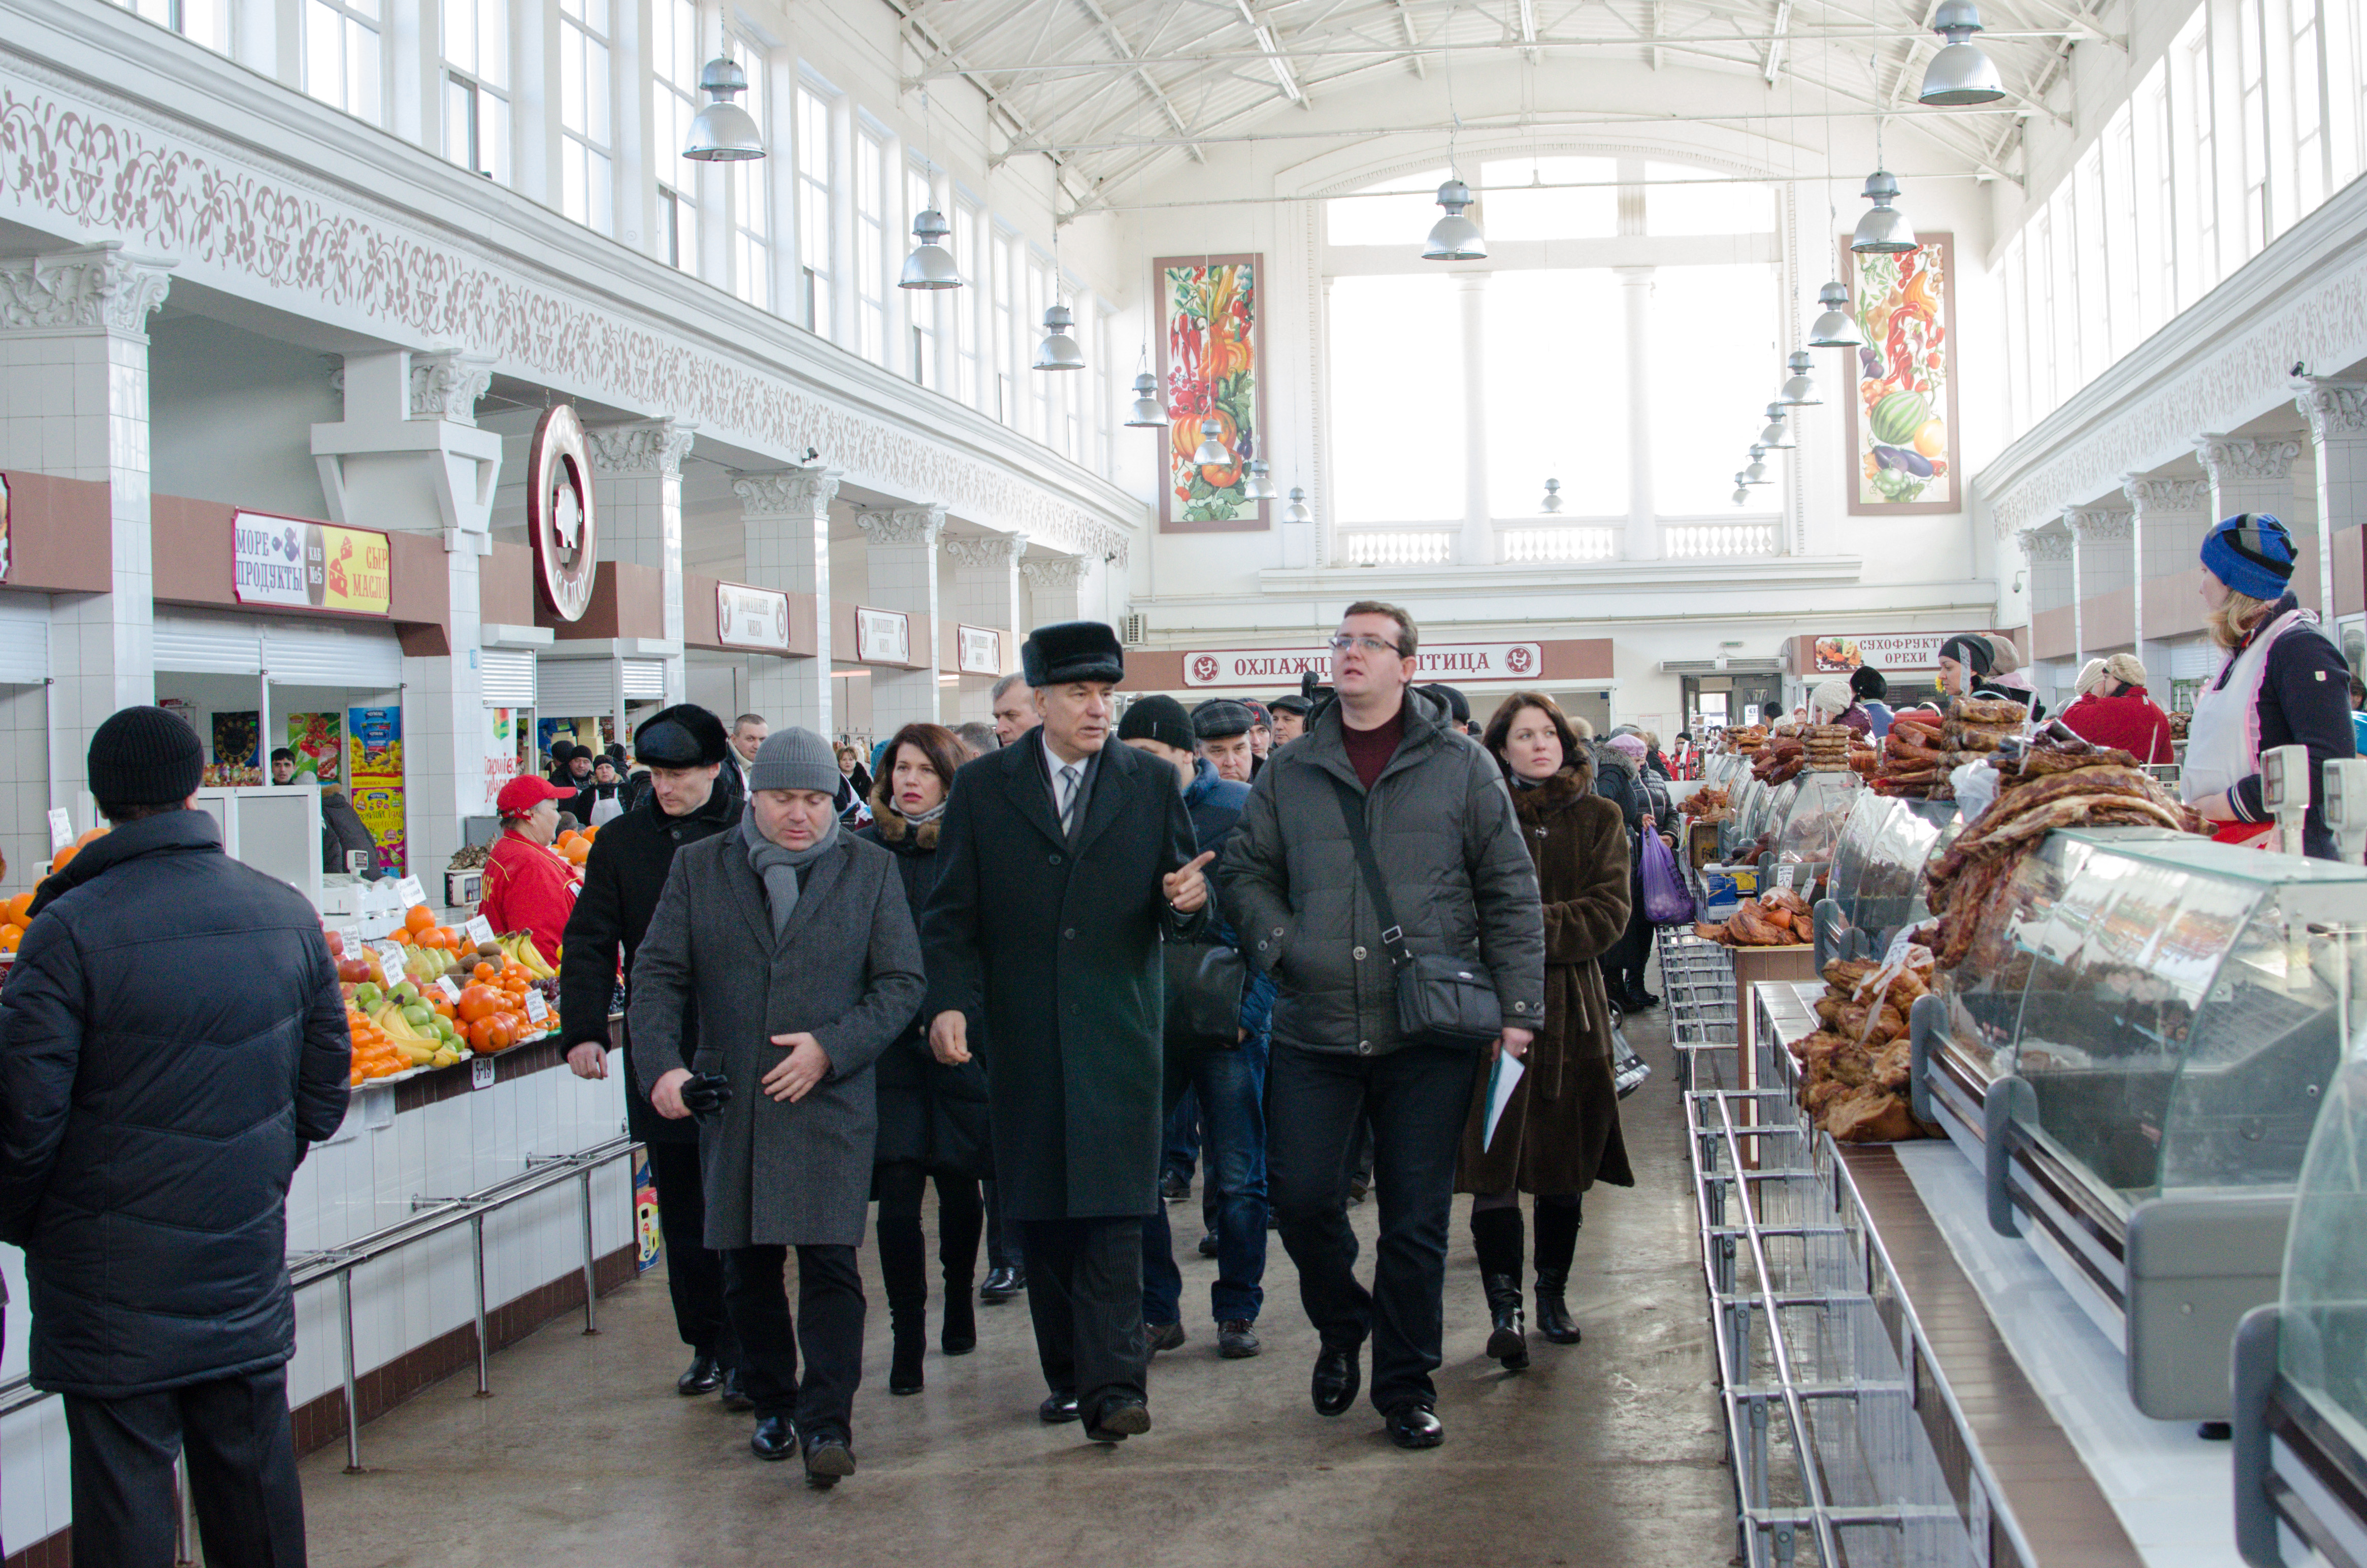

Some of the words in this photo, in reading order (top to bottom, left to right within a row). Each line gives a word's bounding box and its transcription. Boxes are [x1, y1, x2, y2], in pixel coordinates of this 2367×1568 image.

[235, 528, 270, 557] МОРЕ
[308, 546, 322, 561] КАБ
[366, 546, 388, 570] СЫР
[236, 560, 304, 593] ПРОДУКТЫ
[308, 566, 322, 584] №5
[352, 573, 388, 600] МАСЛО
[554, 569, 586, 611] САЛО
[738, 595, 769, 615] ДОМАШНЕЕ
[747, 619, 762, 637] МЯСО
[872, 617, 894, 635] ДОМАШНЕЕ
[878, 638, 890, 654] МЯСО
[1234, 657, 1333, 677] ОХЛАЖД
[1885, 652, 1927, 664] ОРЕХИ
[476, 1059, 491, 1081] 5-19
